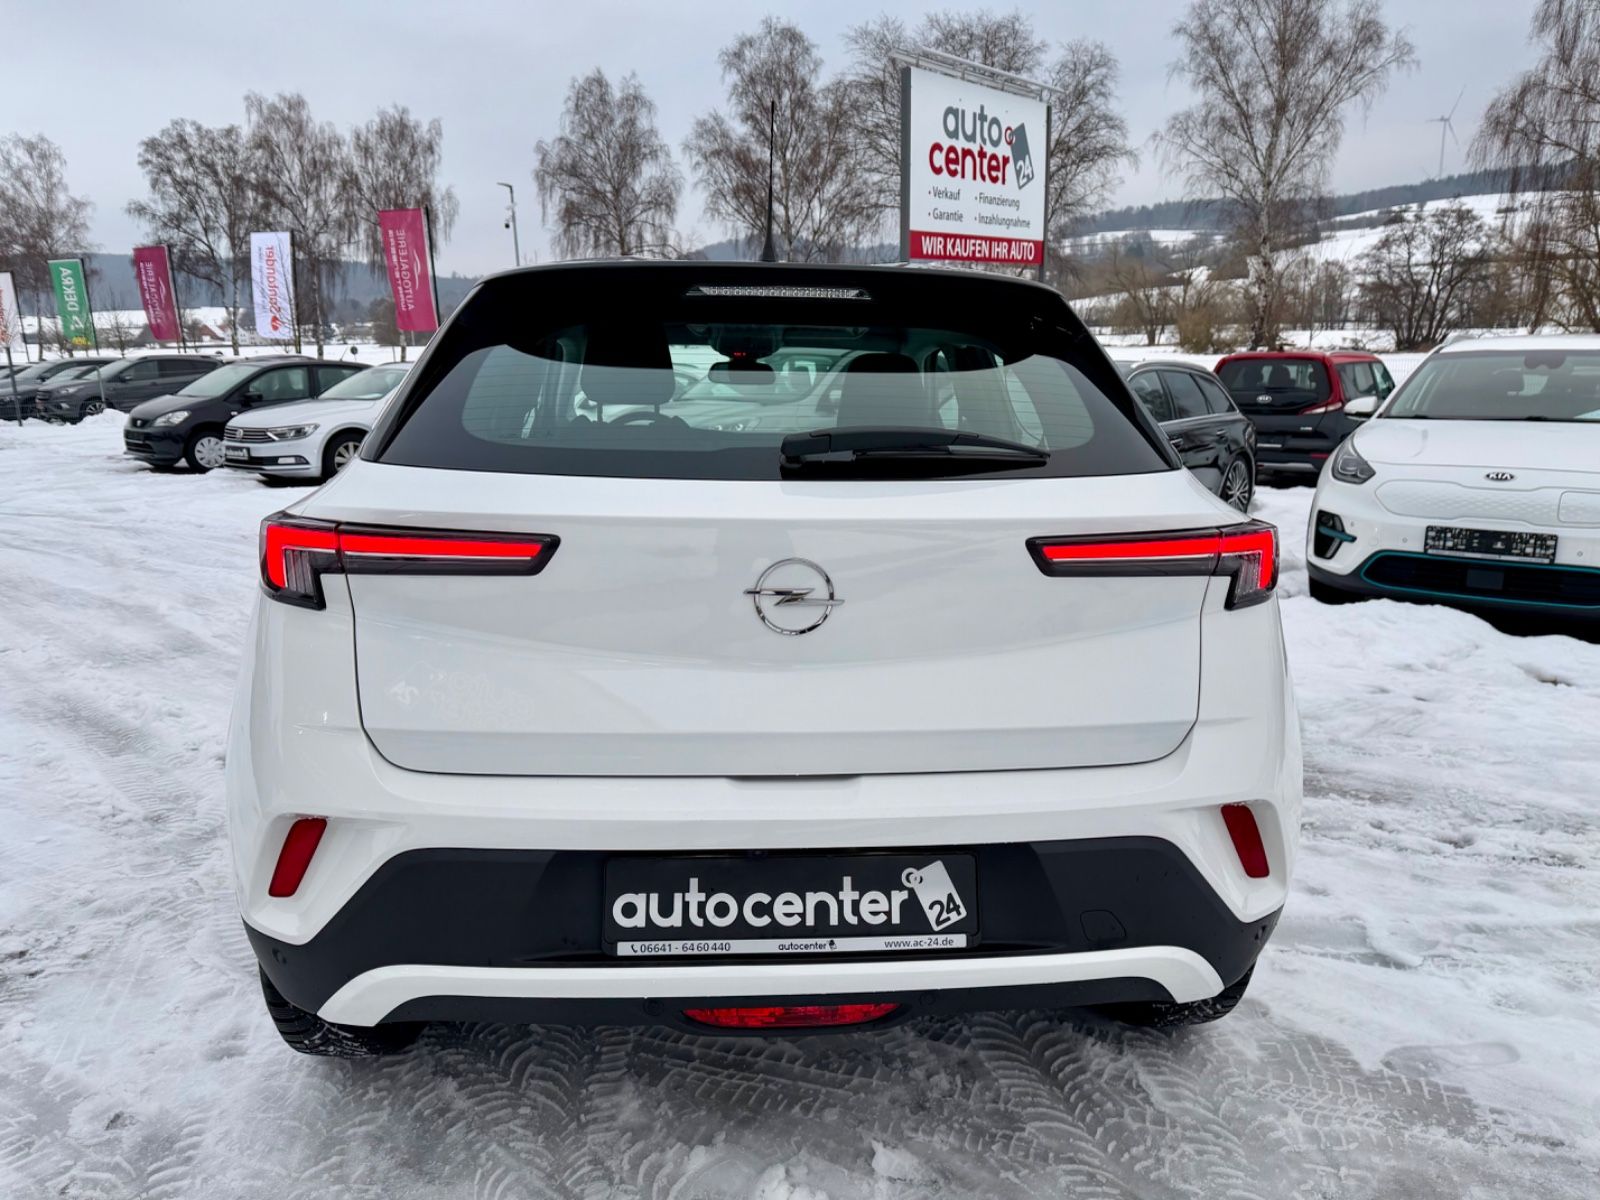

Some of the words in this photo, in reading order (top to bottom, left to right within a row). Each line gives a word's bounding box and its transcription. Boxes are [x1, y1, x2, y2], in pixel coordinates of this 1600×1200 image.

[943, 104, 1002, 148] auto
[929, 142, 1010, 185] center
[1016, 154, 1033, 185] 24
[932, 186, 961, 201] Verkauf
[978, 192, 1020, 211] Finanzierung
[932, 207, 964, 222] Garantie
[978, 212, 1031, 229] Inzahlungnahme
[921, 235, 944, 256] WIR
[946, 237, 989, 258] KAUFEN
[991, 241, 1009, 259] IHR
[1009, 240, 1035, 261] AUTO
[1486, 471, 1514, 481] KIA
[612, 876, 909, 928] autocenter
[928, 892, 963, 928] 24
[640, 943, 672, 953] 06641
[778, 942, 827, 951] autocenter
[884, 937, 954, 949] www.ac-24.de
